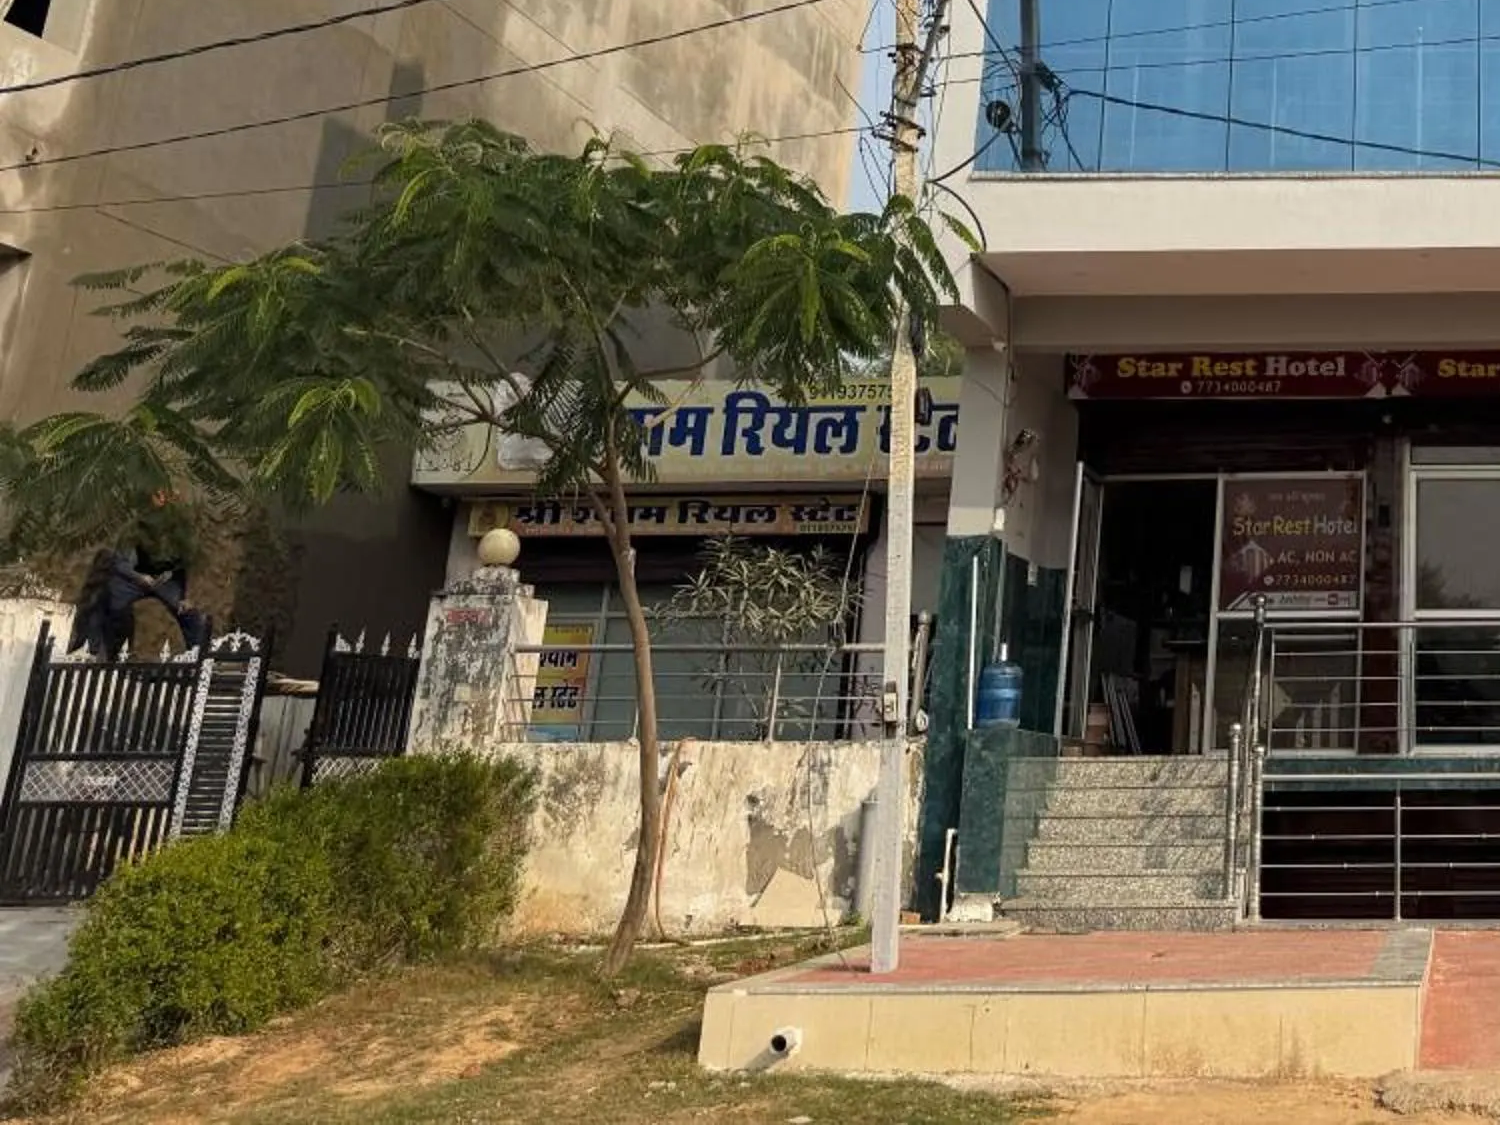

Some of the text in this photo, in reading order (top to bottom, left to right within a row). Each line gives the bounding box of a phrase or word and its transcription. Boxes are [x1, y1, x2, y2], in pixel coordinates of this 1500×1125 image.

[1116, 355, 1346, 378] Star Rest Hotel
[721, 390, 867, 456] रियल
[677, 499, 782, 523] रियल
[1232, 514, 1358, 536] Star Rest Hotel
[1305, 549, 1335, 564] NON
[1339, 549, 1358, 564] AC
